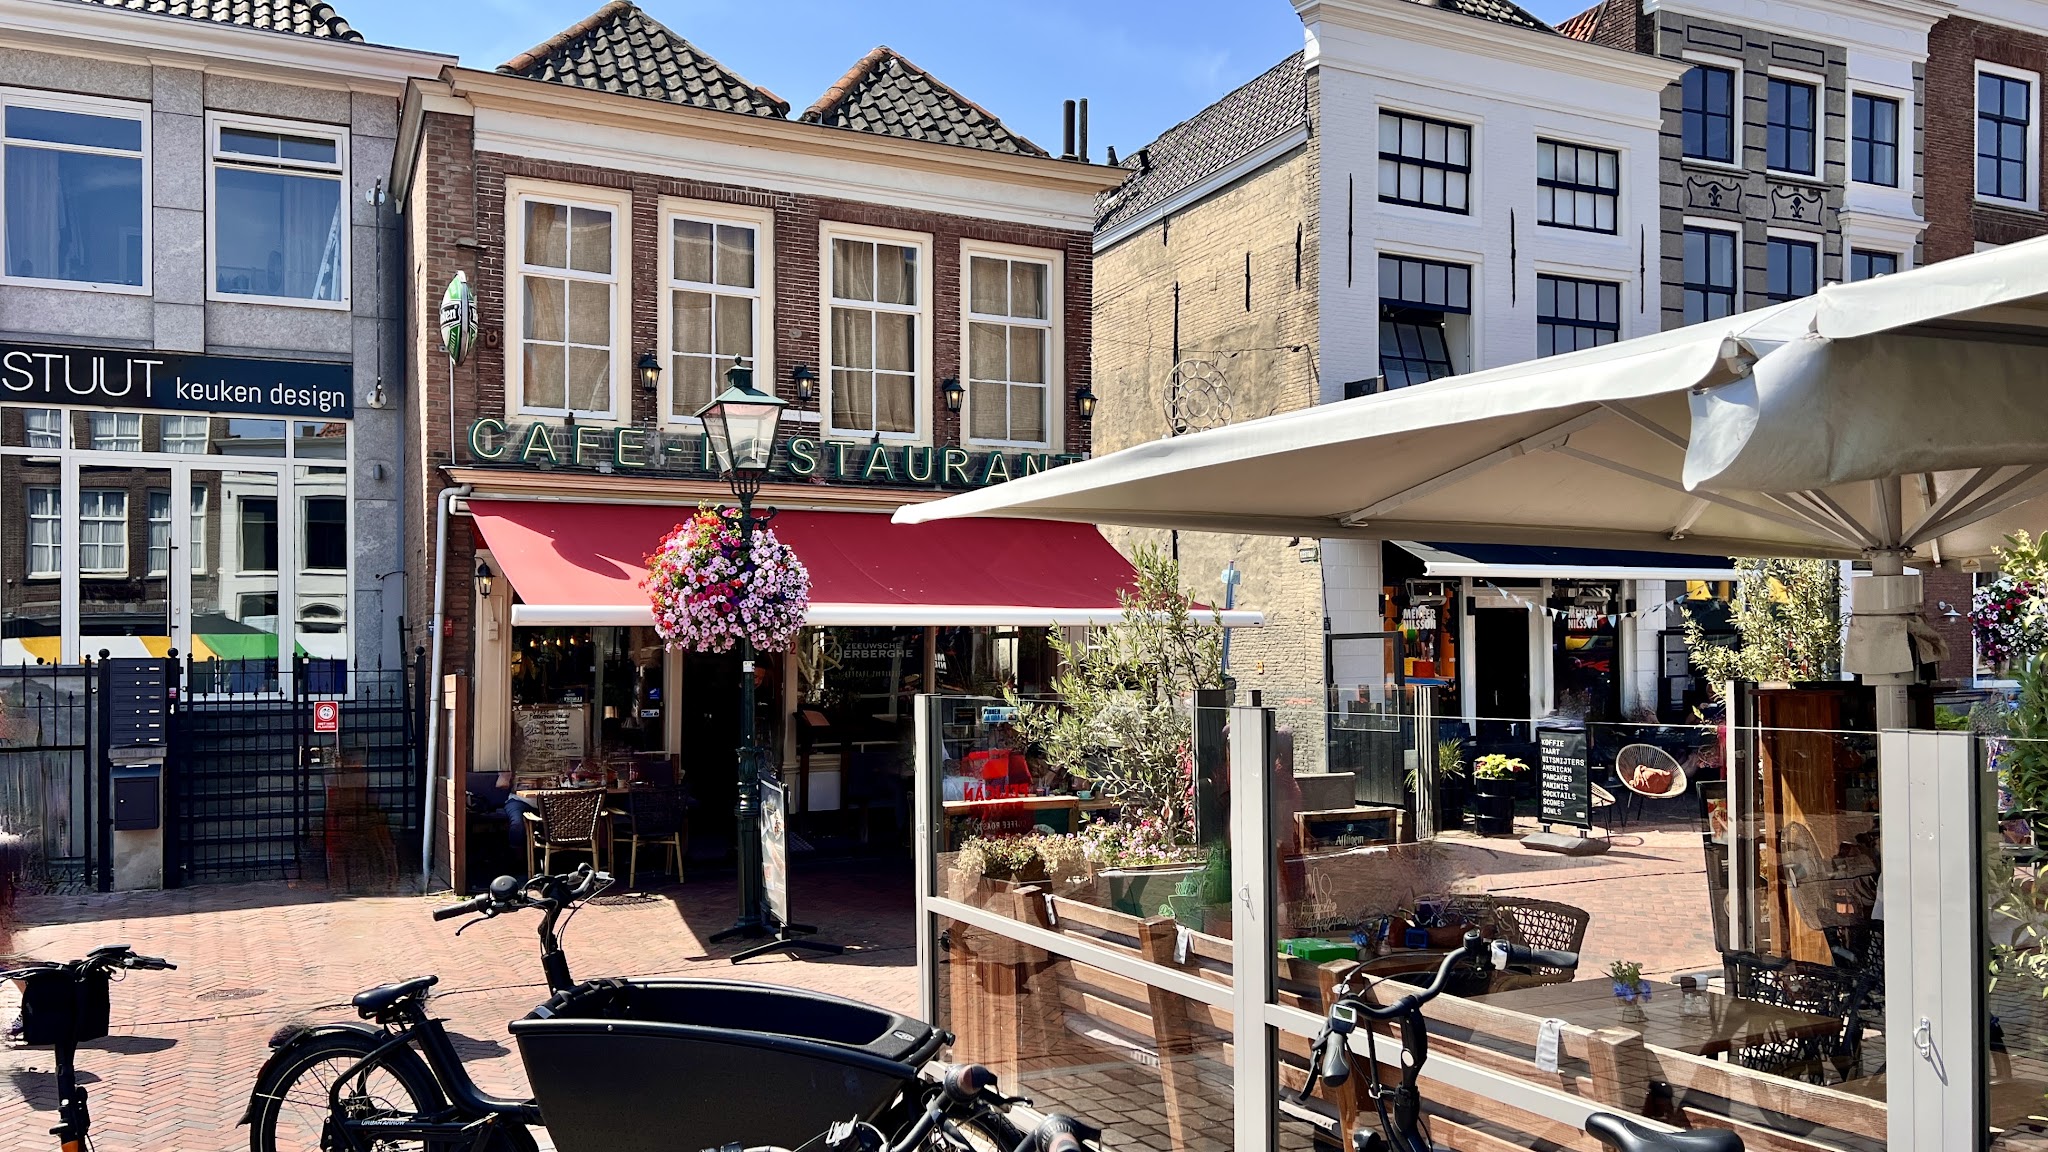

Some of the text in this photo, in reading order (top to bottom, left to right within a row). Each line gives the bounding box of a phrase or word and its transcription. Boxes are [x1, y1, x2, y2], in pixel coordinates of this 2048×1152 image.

[1, 350, 346, 412] STUUT keuken design
[701, 432, 1083, 487] RESTAURAN
[1568, 619, 1598, 629] NILSSN
[846, 642, 902, 650] ZEEUWSCHE
[833, 649, 914, 659] HERBERGHE
[1541, 739, 1564, 747] KOFFIE
[1542, 747, 1560, 755] TAART
[1542, 756, 1585, 767] UITSMIJTERS
[1542, 764, 1572, 774] AMERICAN
[1542, 773, 1573, 782] PANCAKES
[1542, 790, 1576, 800] COCKTAILS
[1542, 798, 1565, 808] SCONES
[1543, 806, 1562, 815] BOWLS
